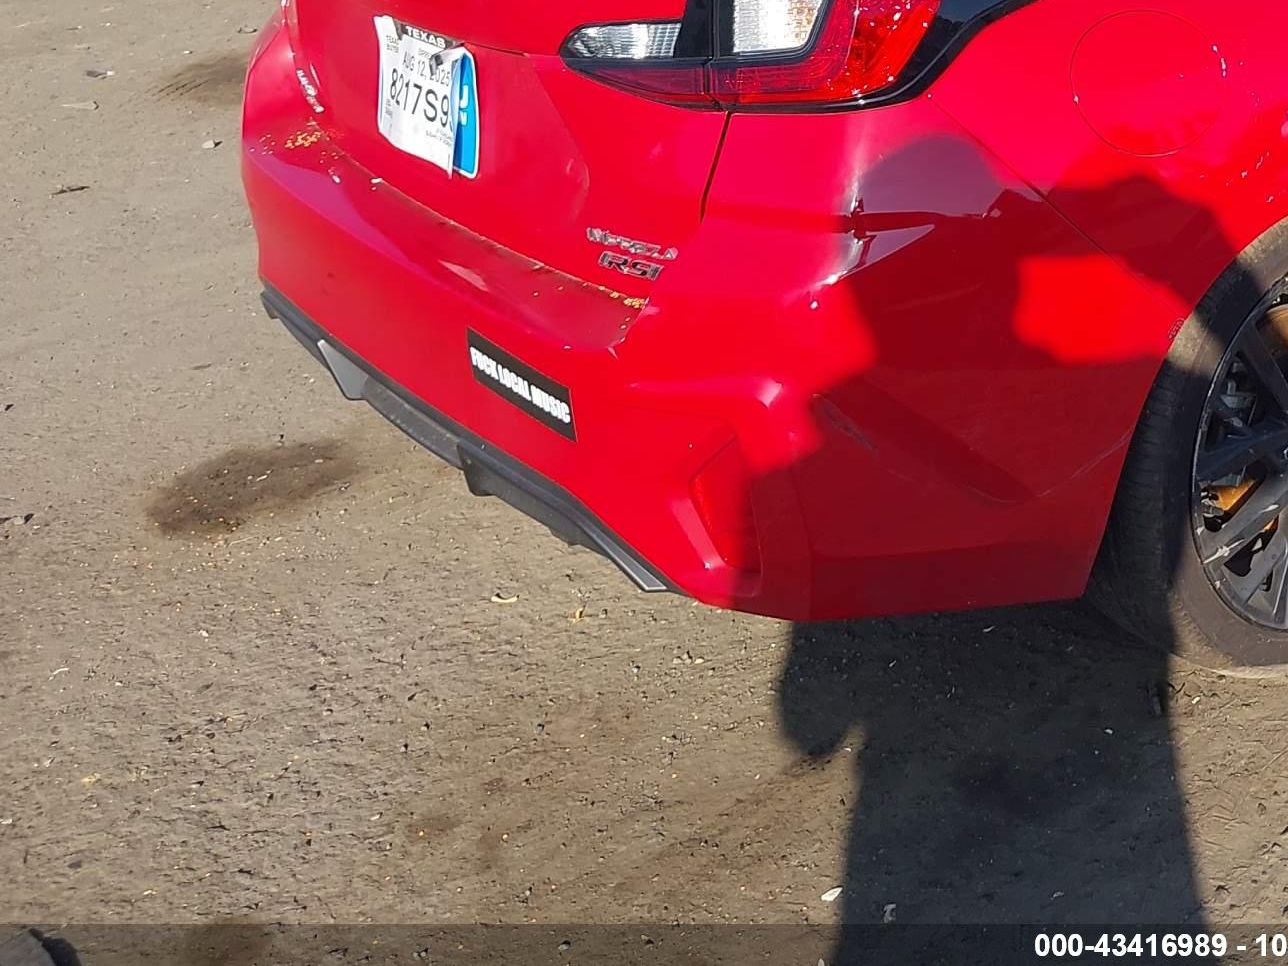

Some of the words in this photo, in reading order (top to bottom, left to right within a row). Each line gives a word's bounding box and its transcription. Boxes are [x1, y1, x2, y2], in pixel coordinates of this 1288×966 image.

[405, 25, 446, 48] TEXAS
[402, 51, 415, 72] AUG
[417, 60, 427, 80] 12,
[390, 68, 454, 132] 8217S9
[598, 250, 664, 281] RS
[497, 363, 532, 402] LOCAL
[530, 384, 571, 424] MUSIC
